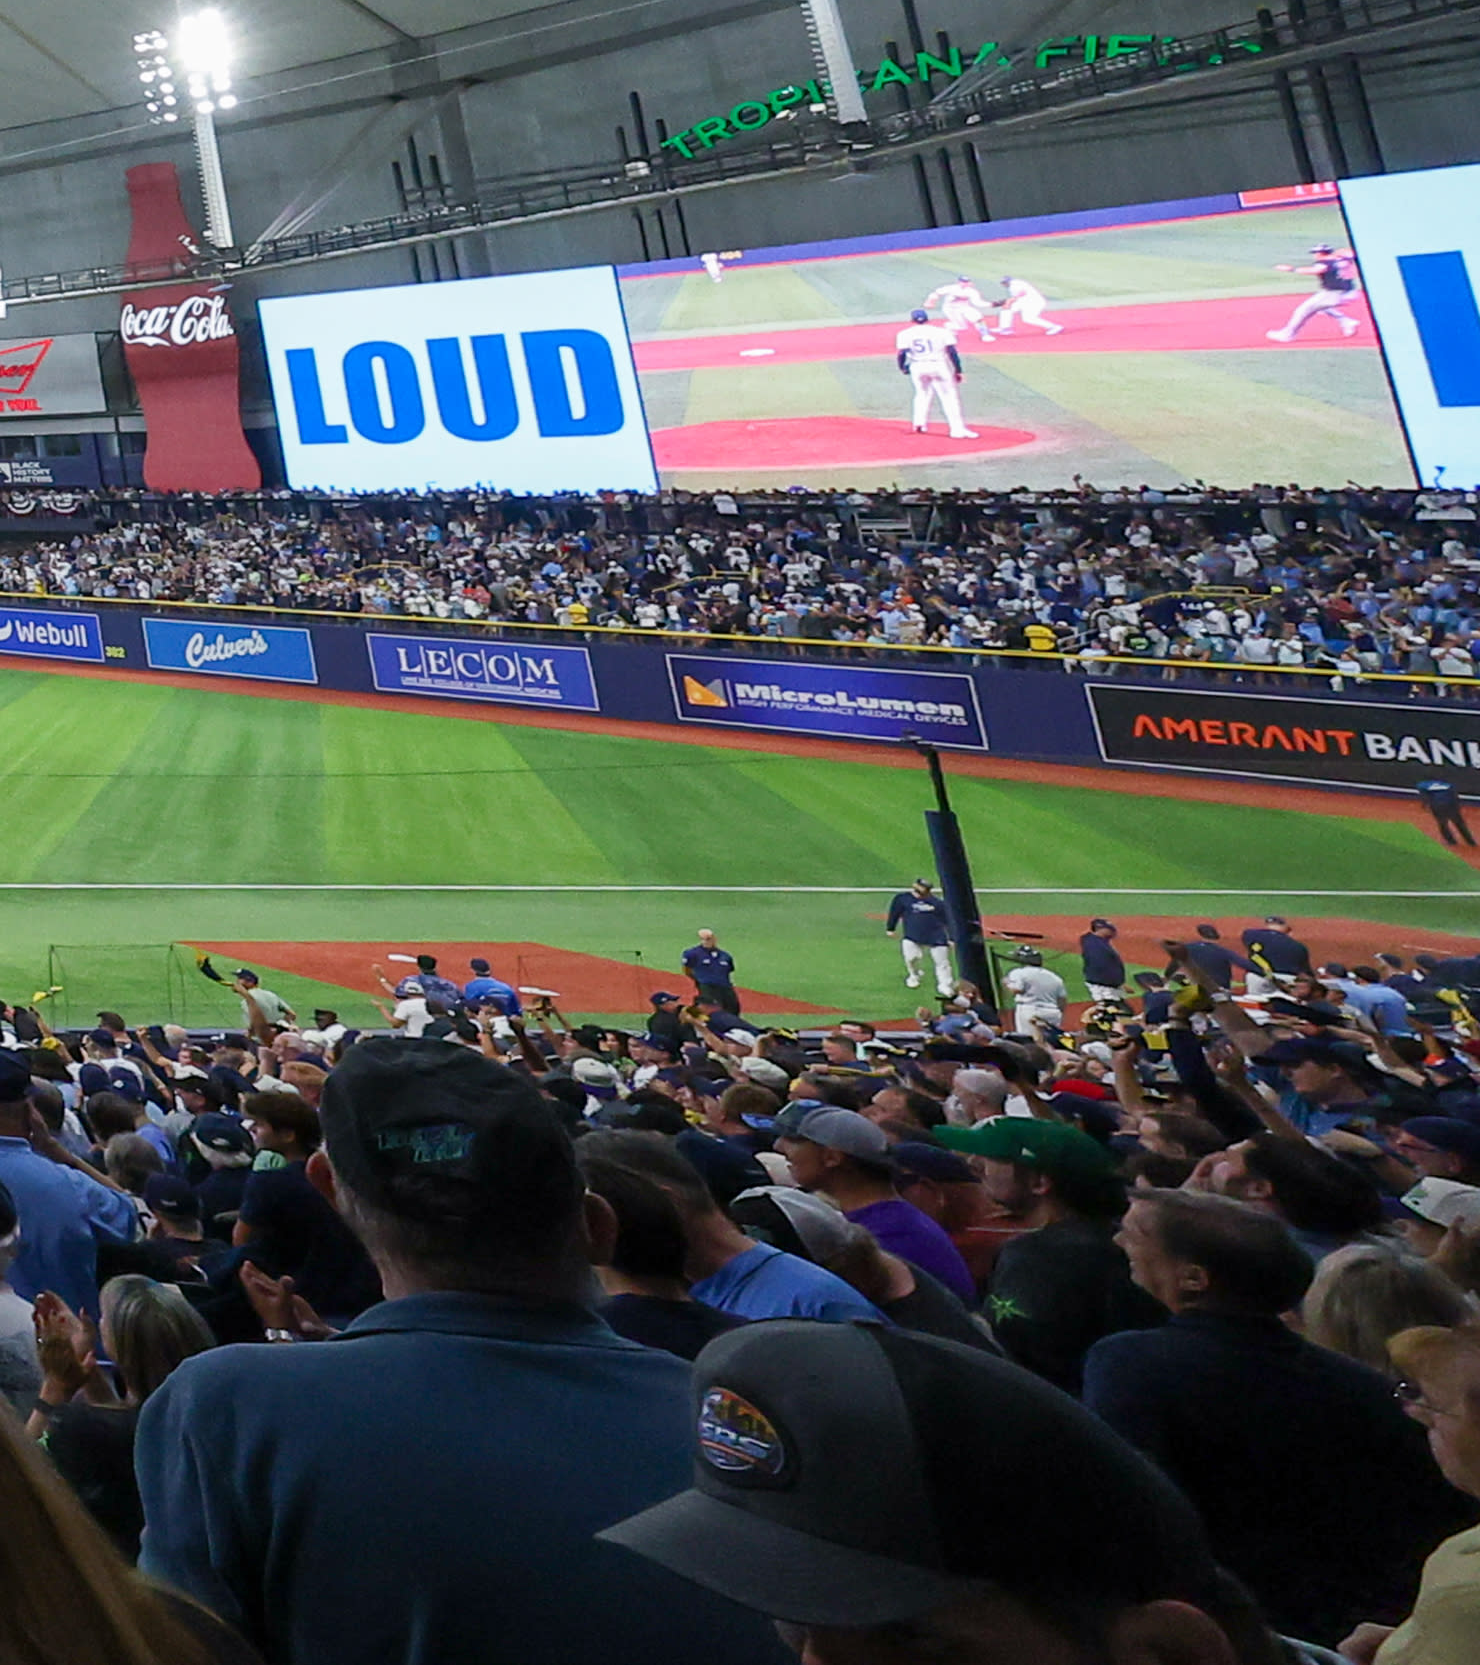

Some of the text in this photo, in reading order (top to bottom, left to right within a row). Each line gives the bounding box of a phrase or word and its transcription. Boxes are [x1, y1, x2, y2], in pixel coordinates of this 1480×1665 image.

[661, 34, 1264, 161] TROPIANA FIE
[120, 295, 234, 347] Coca-Cola
[285, 329, 625, 445] LOUD
[15, 619, 88, 648] Webull
[185, 630, 268, 668] Culver's
[735, 682, 965, 717] MicroLumen
[738, 698, 768, 708] HIGH
[770, 701, 854, 716] PERFORMANCE
[914, 713, 969, 726] DEVICES
[1133, 714, 1355, 756] AMERANT
